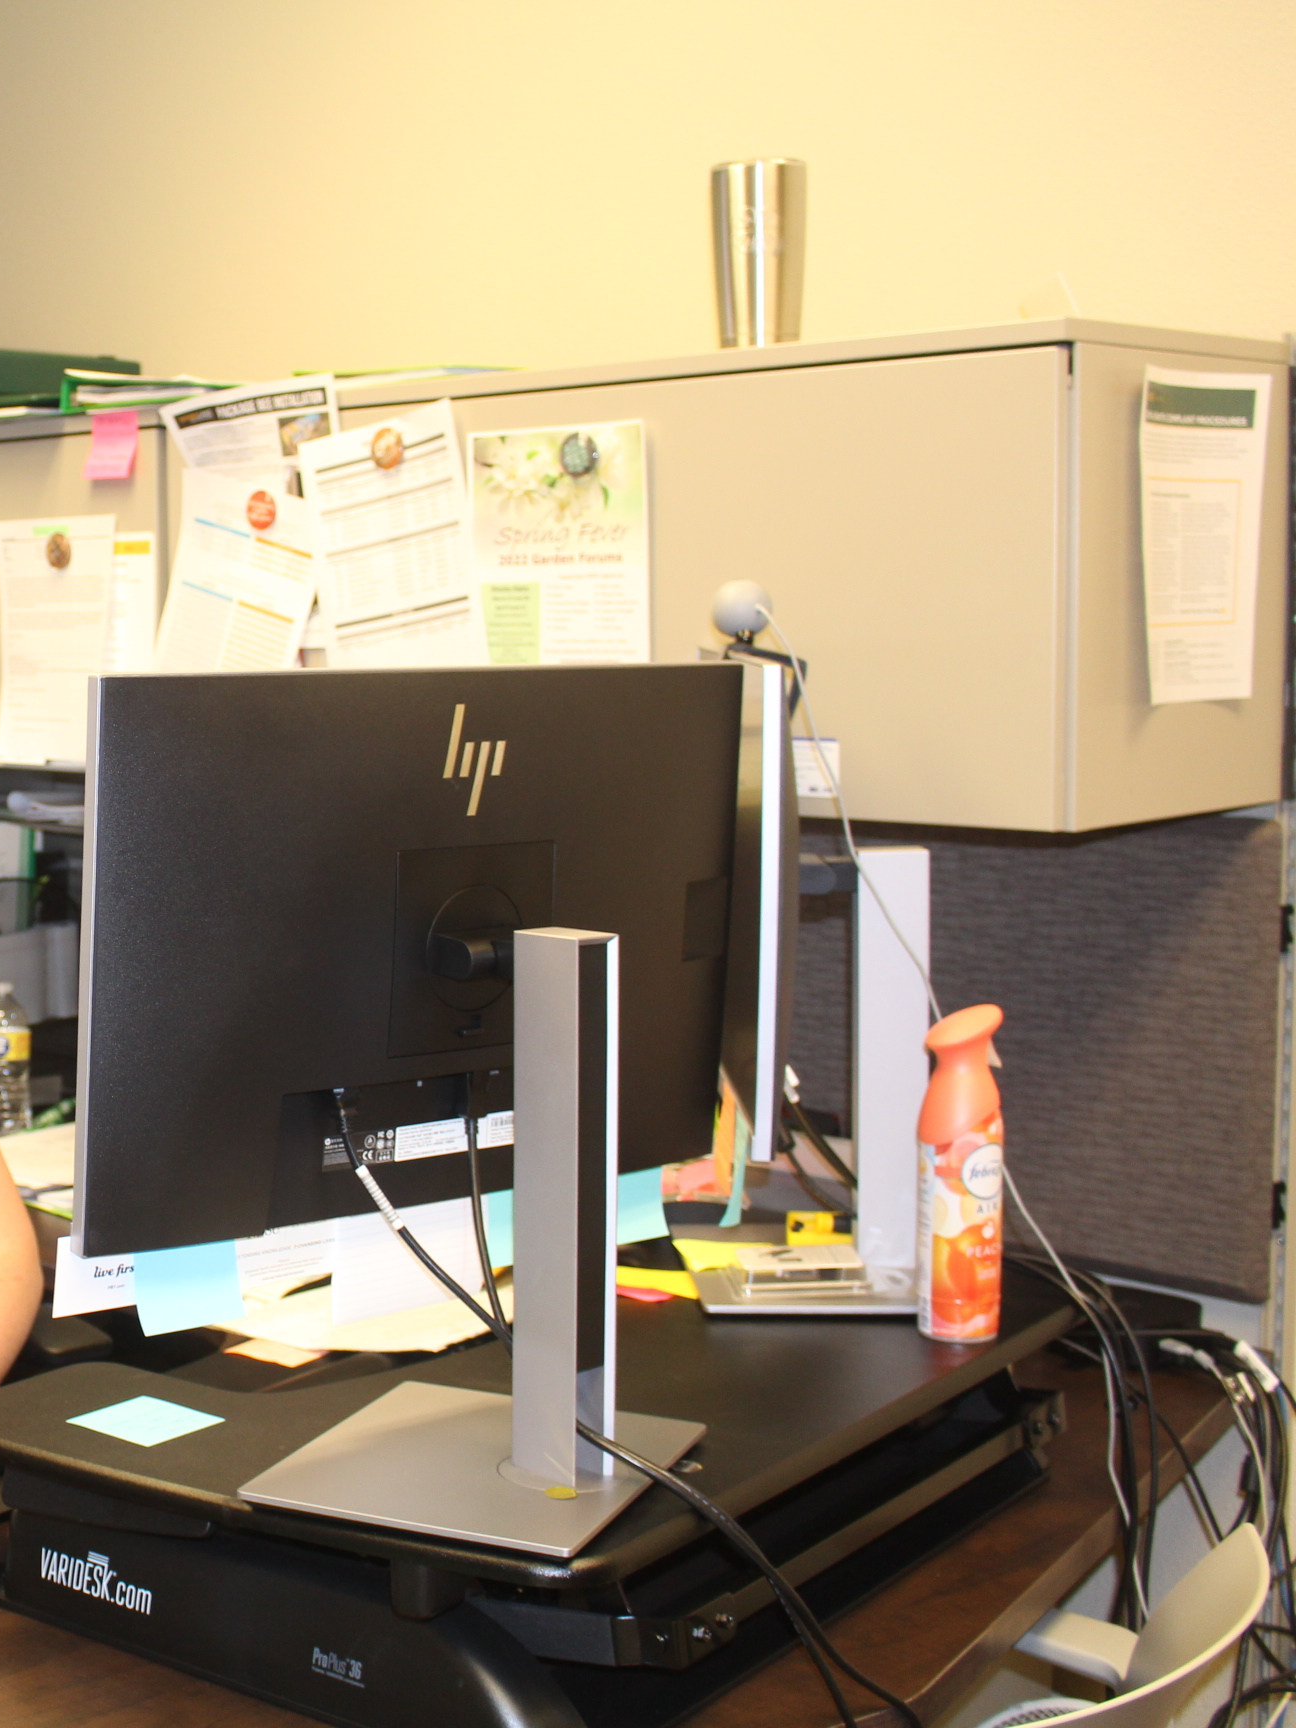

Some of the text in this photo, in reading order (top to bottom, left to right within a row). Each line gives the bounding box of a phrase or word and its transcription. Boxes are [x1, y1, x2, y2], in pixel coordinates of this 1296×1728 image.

[493, 522, 630, 551] Spring Fever
[498, 553, 623, 566] 2022 Garden Forums
[443, 703, 506, 816] hp
[977, 1203, 998, 1214] AIR
[966, 1243, 1001, 1258] PEAC
[94, 1263, 134, 1278] live firs
[41, 1547, 152, 1615] VARIDESK.com
[312, 1646, 363, 1680] ProPlus 36
